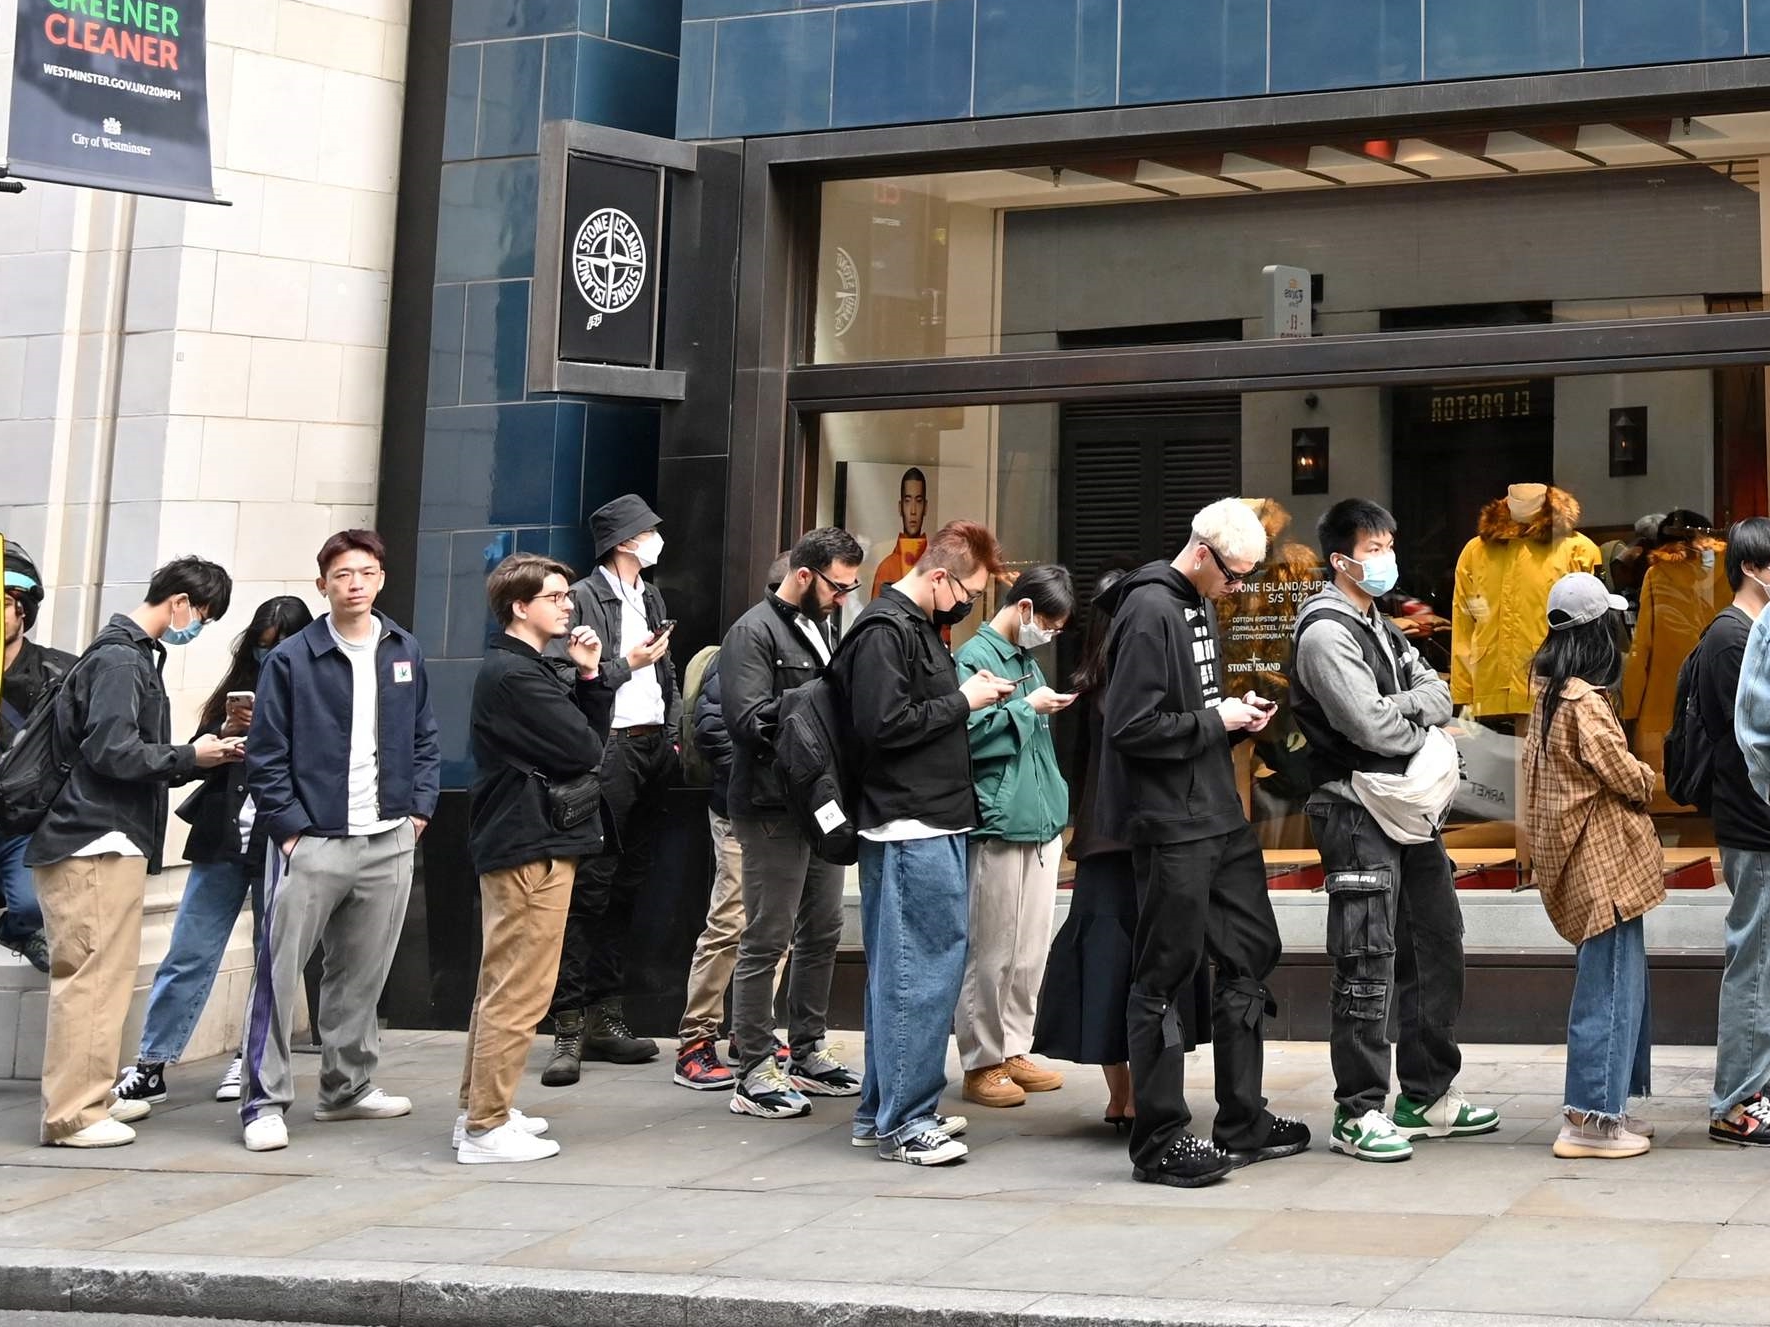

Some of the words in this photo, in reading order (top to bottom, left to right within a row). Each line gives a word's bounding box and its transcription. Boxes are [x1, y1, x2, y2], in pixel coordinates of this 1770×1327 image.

[44, 12, 178, 71] CLEANER
[43, 63, 181, 101] WESTMINSTER.GOV.UK/20MPH
[72, 132, 89, 148] City
[90, 136, 100, 148] of
[102, 137, 151, 156] Westminster
[579, 214, 609, 253] STONE
[614, 216, 642, 261] ISLAND
[577, 261, 606, 305] ISLAND
[611, 267, 641, 306] STONE
[1232, 616, 1254, 624] COTTON
[1260, 624, 1277, 632] STEEL
[1227, 663, 1252, 673] STONE
[1255, 662, 1281, 673] ISLAND
